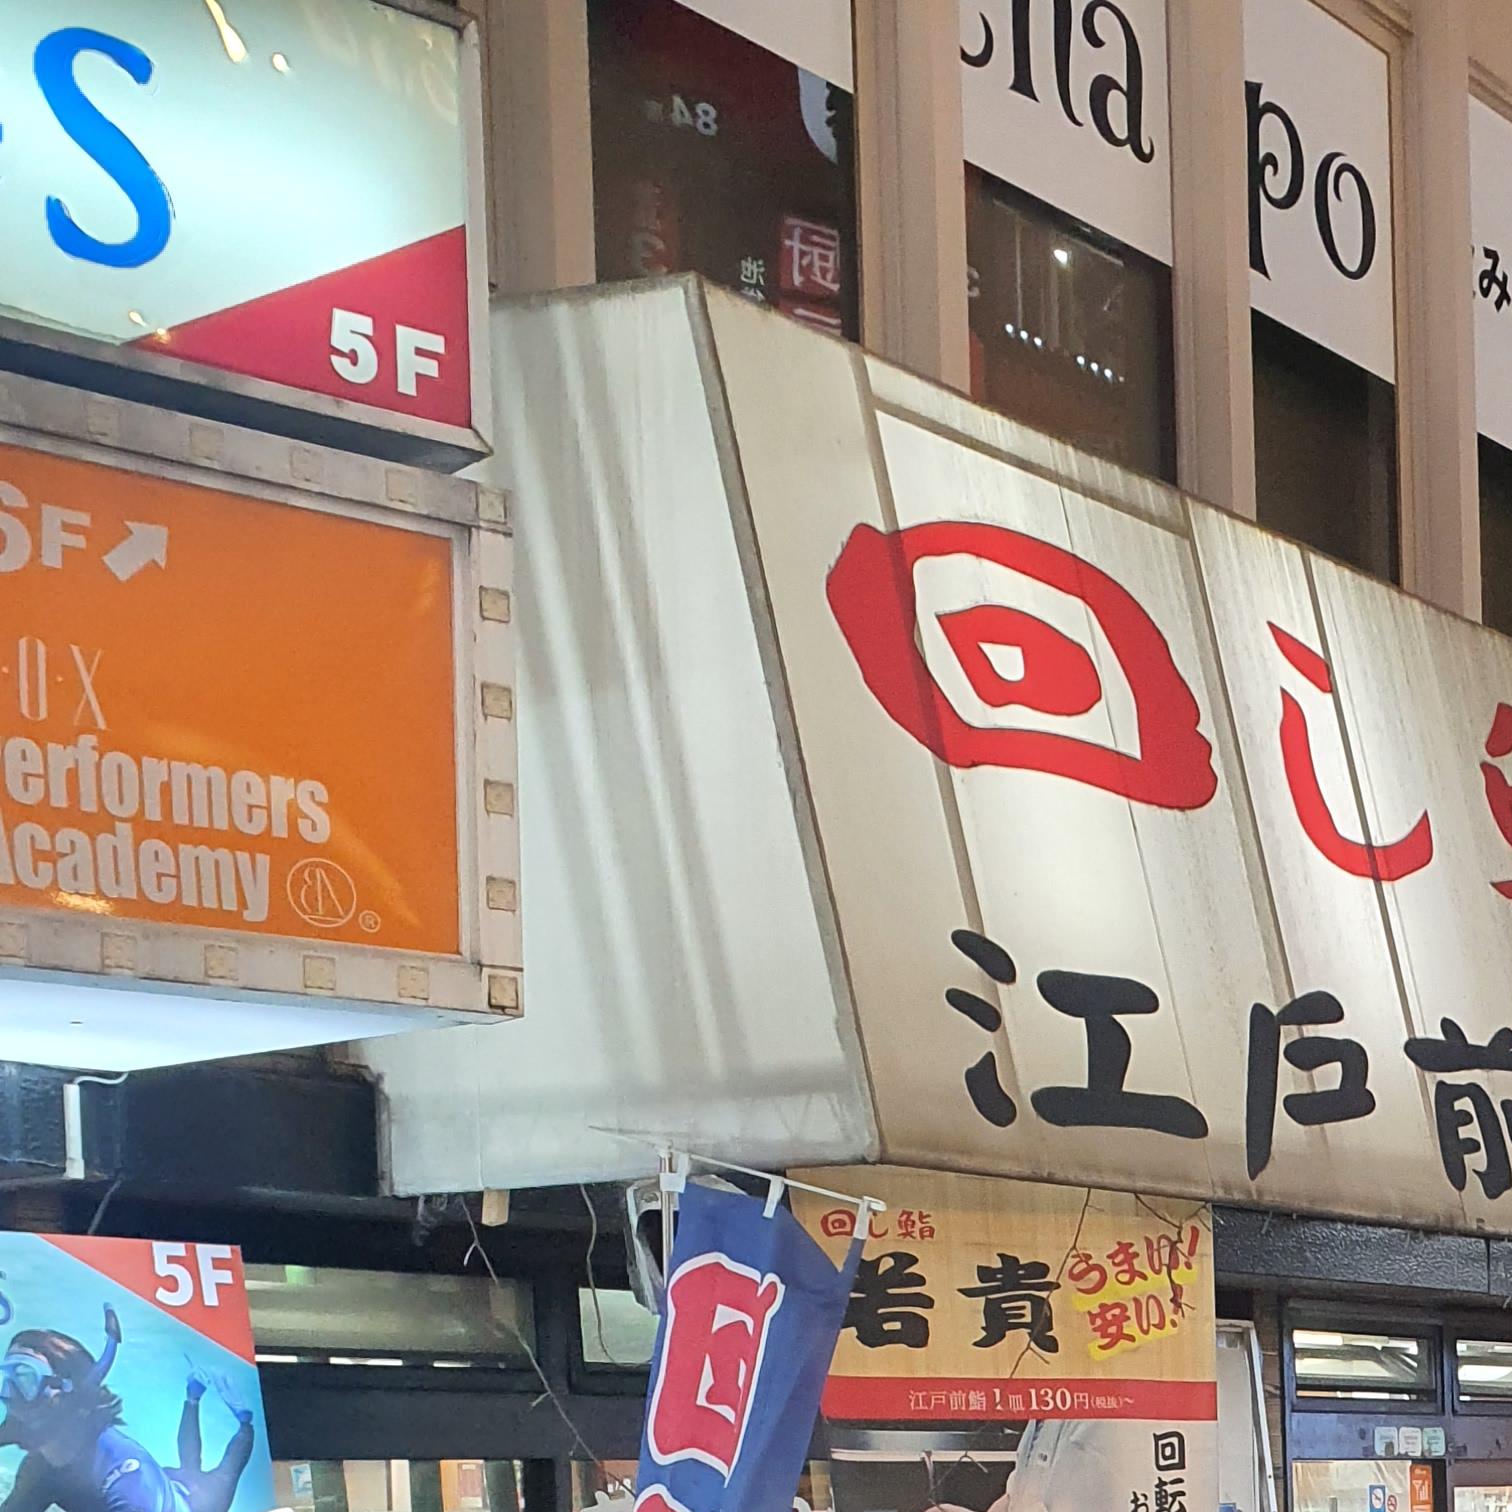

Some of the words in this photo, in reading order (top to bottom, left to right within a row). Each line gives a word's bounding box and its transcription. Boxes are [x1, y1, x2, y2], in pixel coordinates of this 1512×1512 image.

[1245, 78, 1377, 280] po
[330, 307, 446, 397] 5F
[820, 1208, 936, 1241] 回し鮨
[151, 1241, 234, 1308] 5F
[839, 1250, 1062, 1354] 若貴
